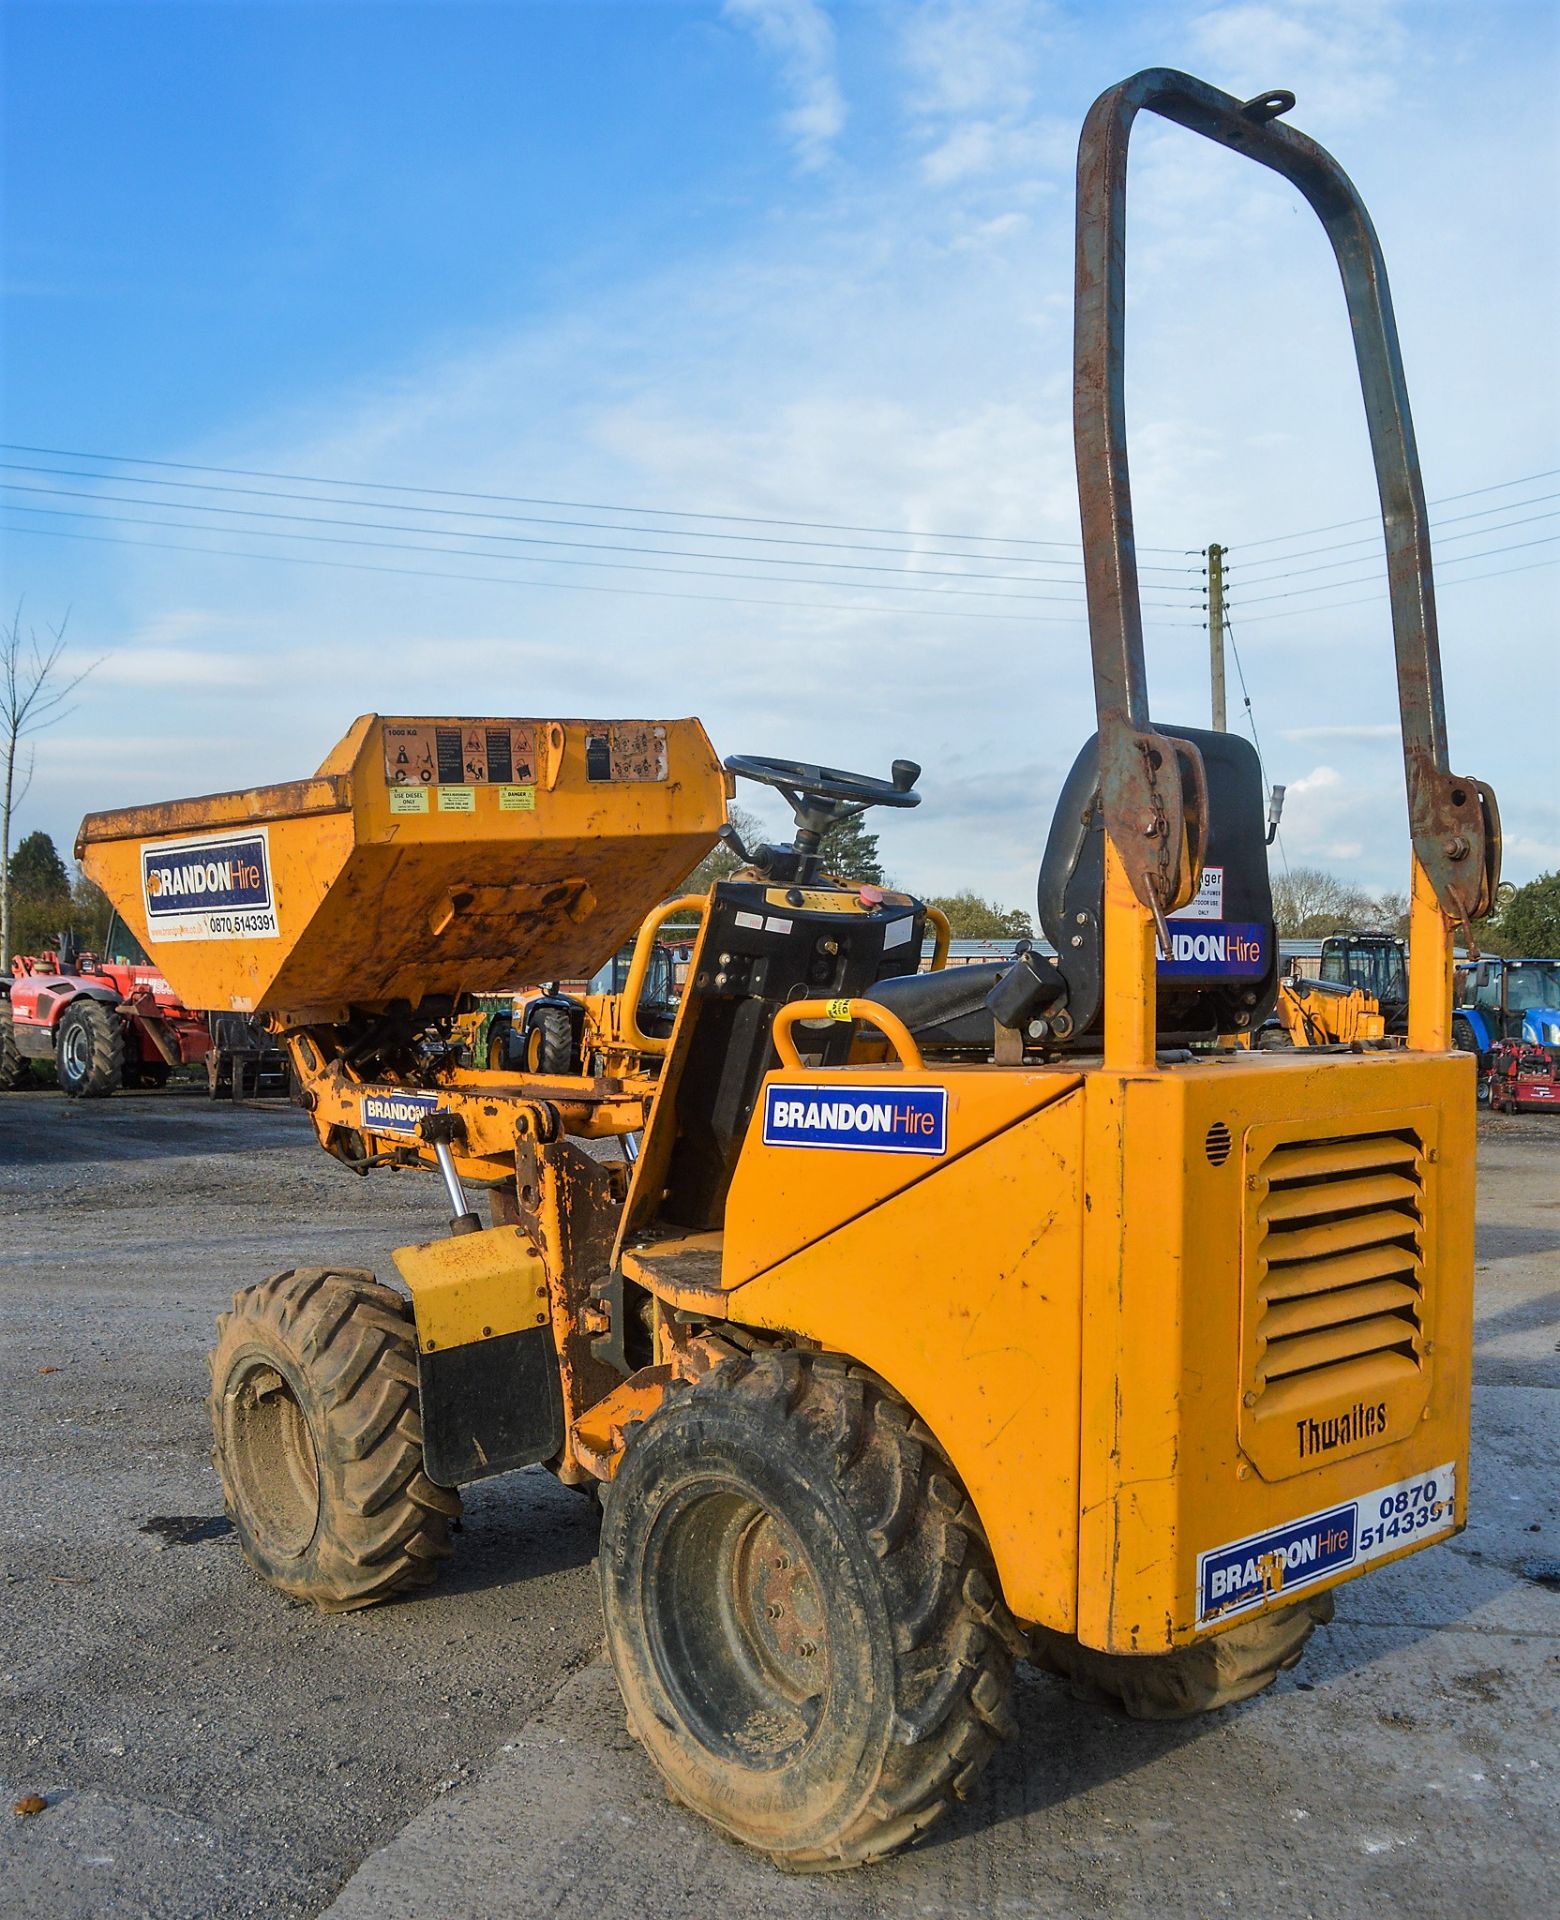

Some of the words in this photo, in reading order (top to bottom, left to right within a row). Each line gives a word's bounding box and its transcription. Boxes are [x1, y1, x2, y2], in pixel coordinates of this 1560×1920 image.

[210, 917, 232, 933] 0870
[234, 914, 275, 932] 5143391
[1296, 1402, 1387, 1458] Thwaites
[1380, 1480, 1437, 1519] 0870
